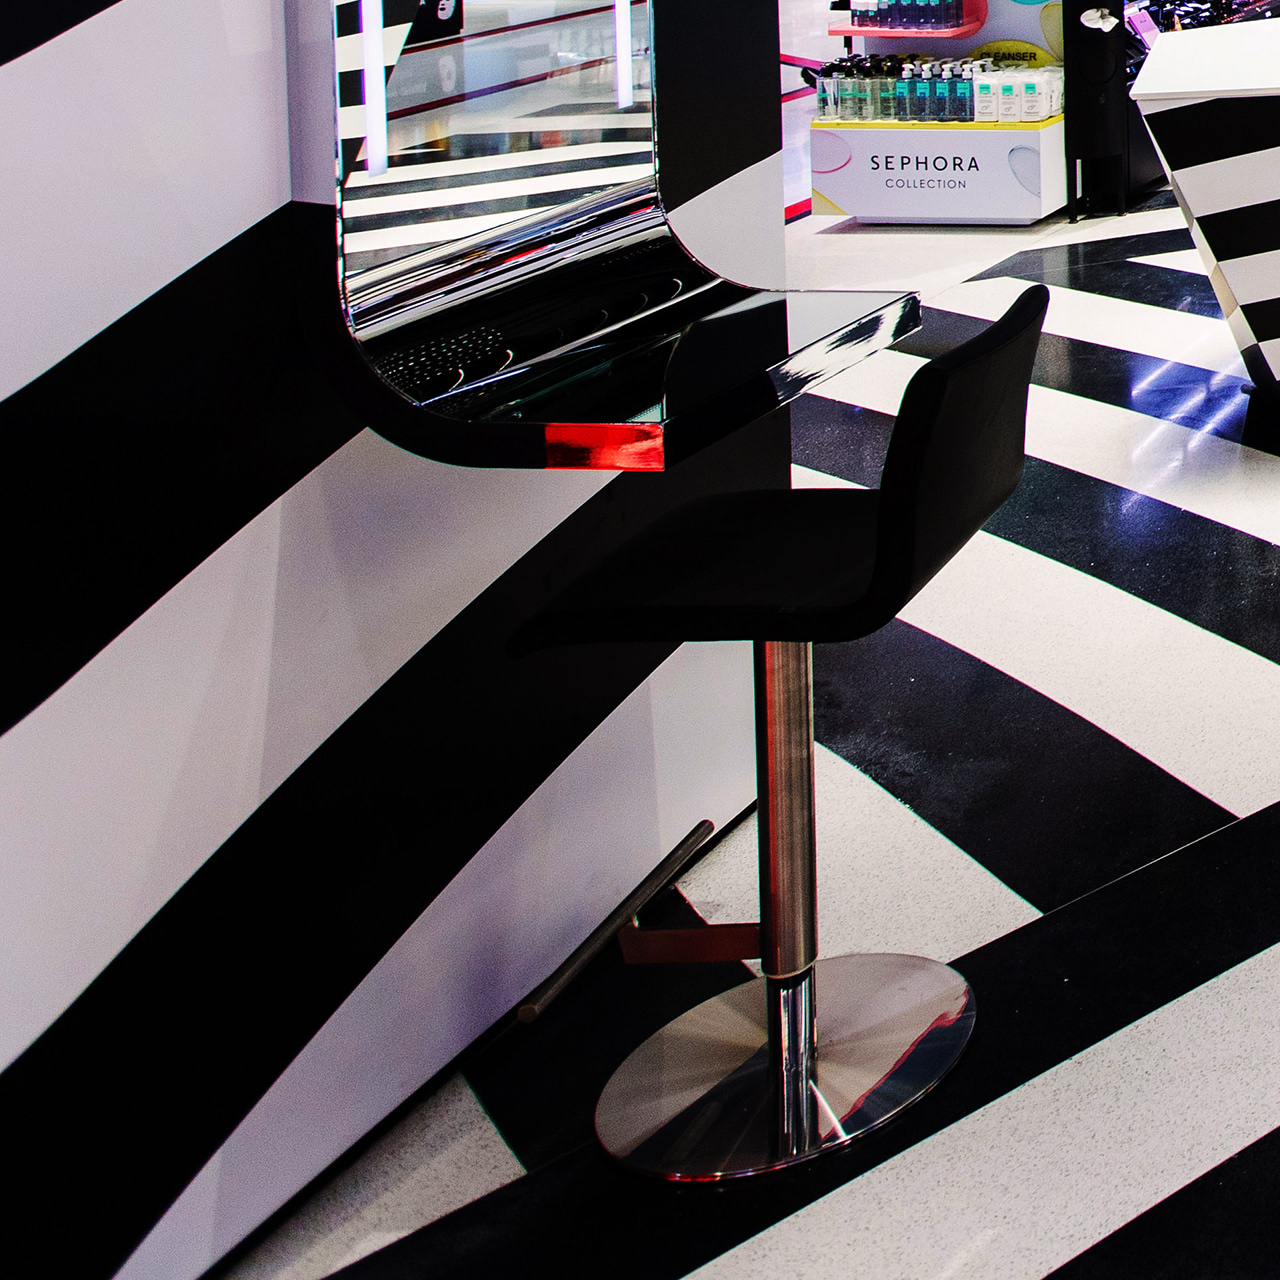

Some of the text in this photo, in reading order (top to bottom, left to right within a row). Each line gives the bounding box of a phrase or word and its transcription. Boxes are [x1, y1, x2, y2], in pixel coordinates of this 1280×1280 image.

[980, 52, 1037, 61] CLEANSER
[870, 155, 980, 171] SEPHORA
[885, 178, 967, 189] COLLECTION
